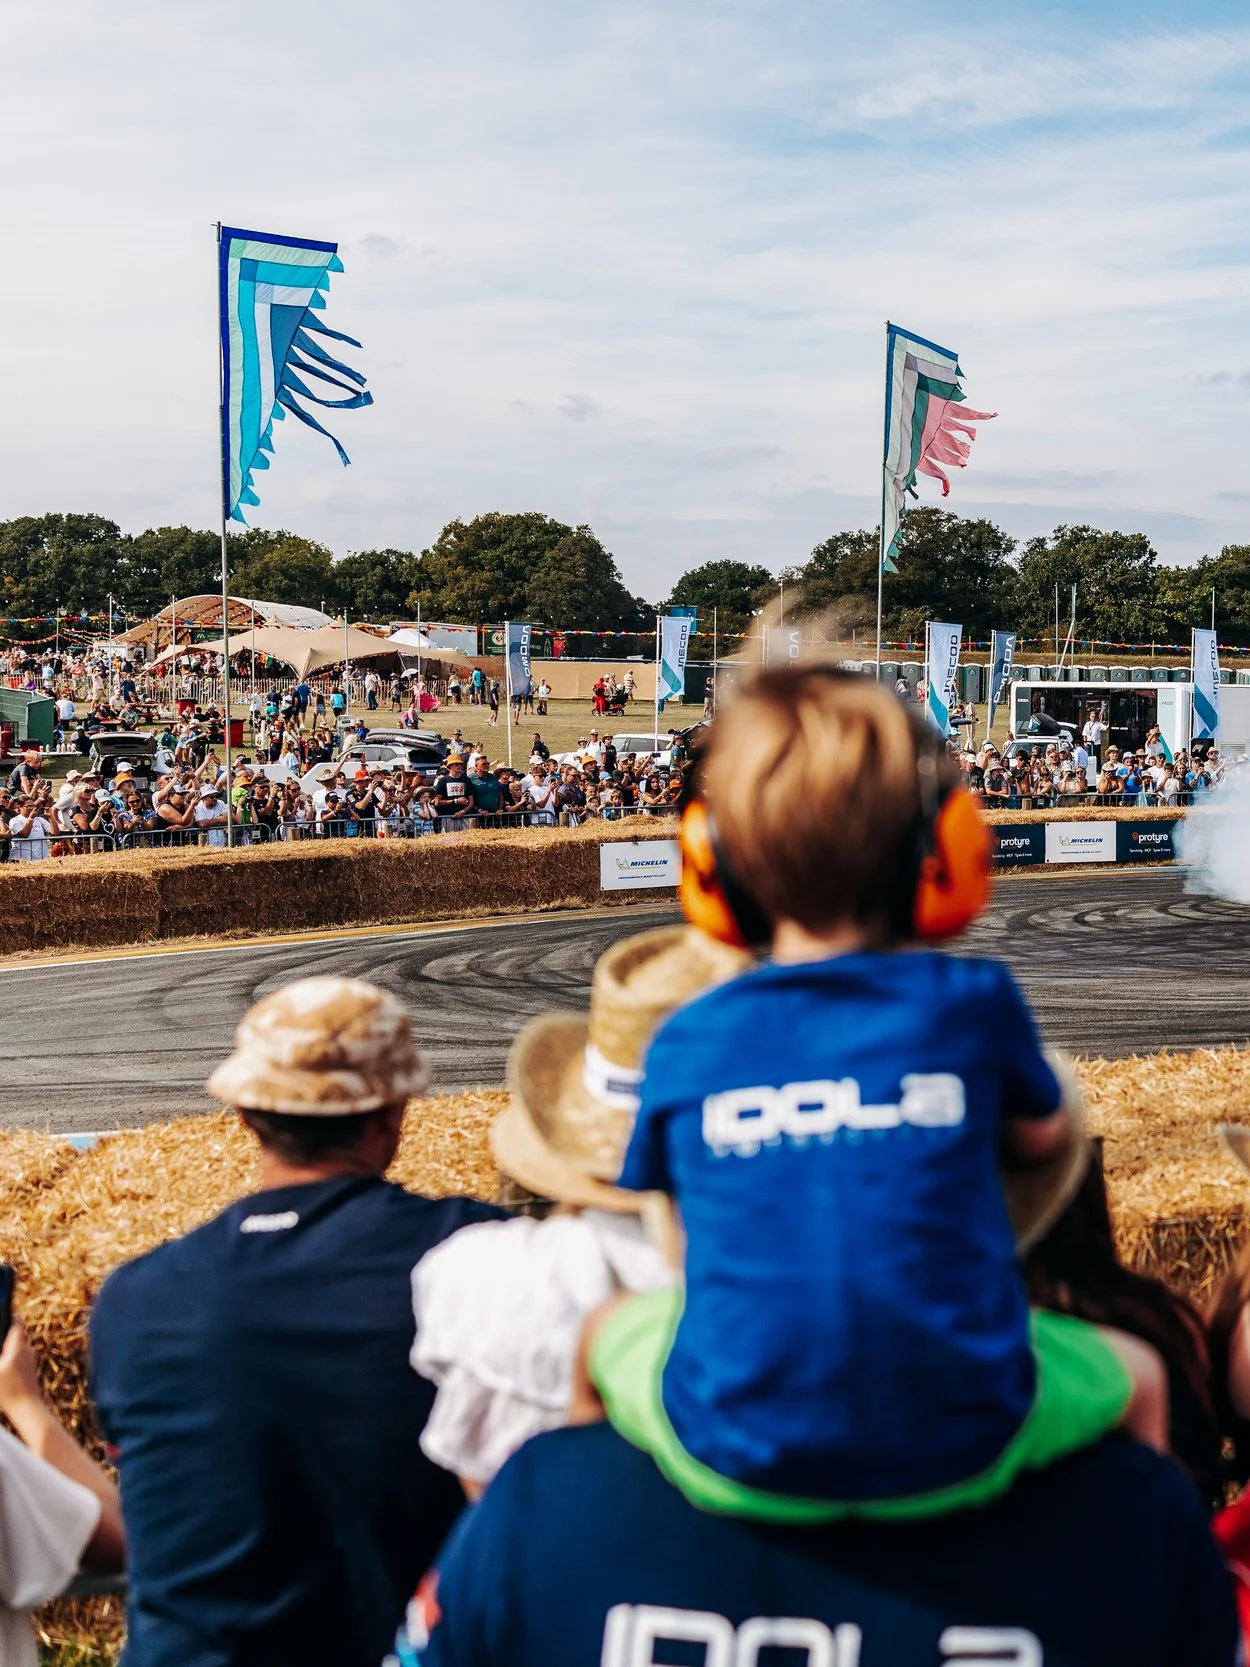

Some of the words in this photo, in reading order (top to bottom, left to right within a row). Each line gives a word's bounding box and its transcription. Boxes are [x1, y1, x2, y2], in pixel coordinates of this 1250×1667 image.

[520, 625, 531, 677] OMODA
[677, 625, 687, 671] JAECOO
[944, 635, 958, 692] JAECOO
[994, 636, 1014, 703] OMODA
[1000, 837, 1030, 849] protyre
[1138, 833, 1169, 844] protyre
